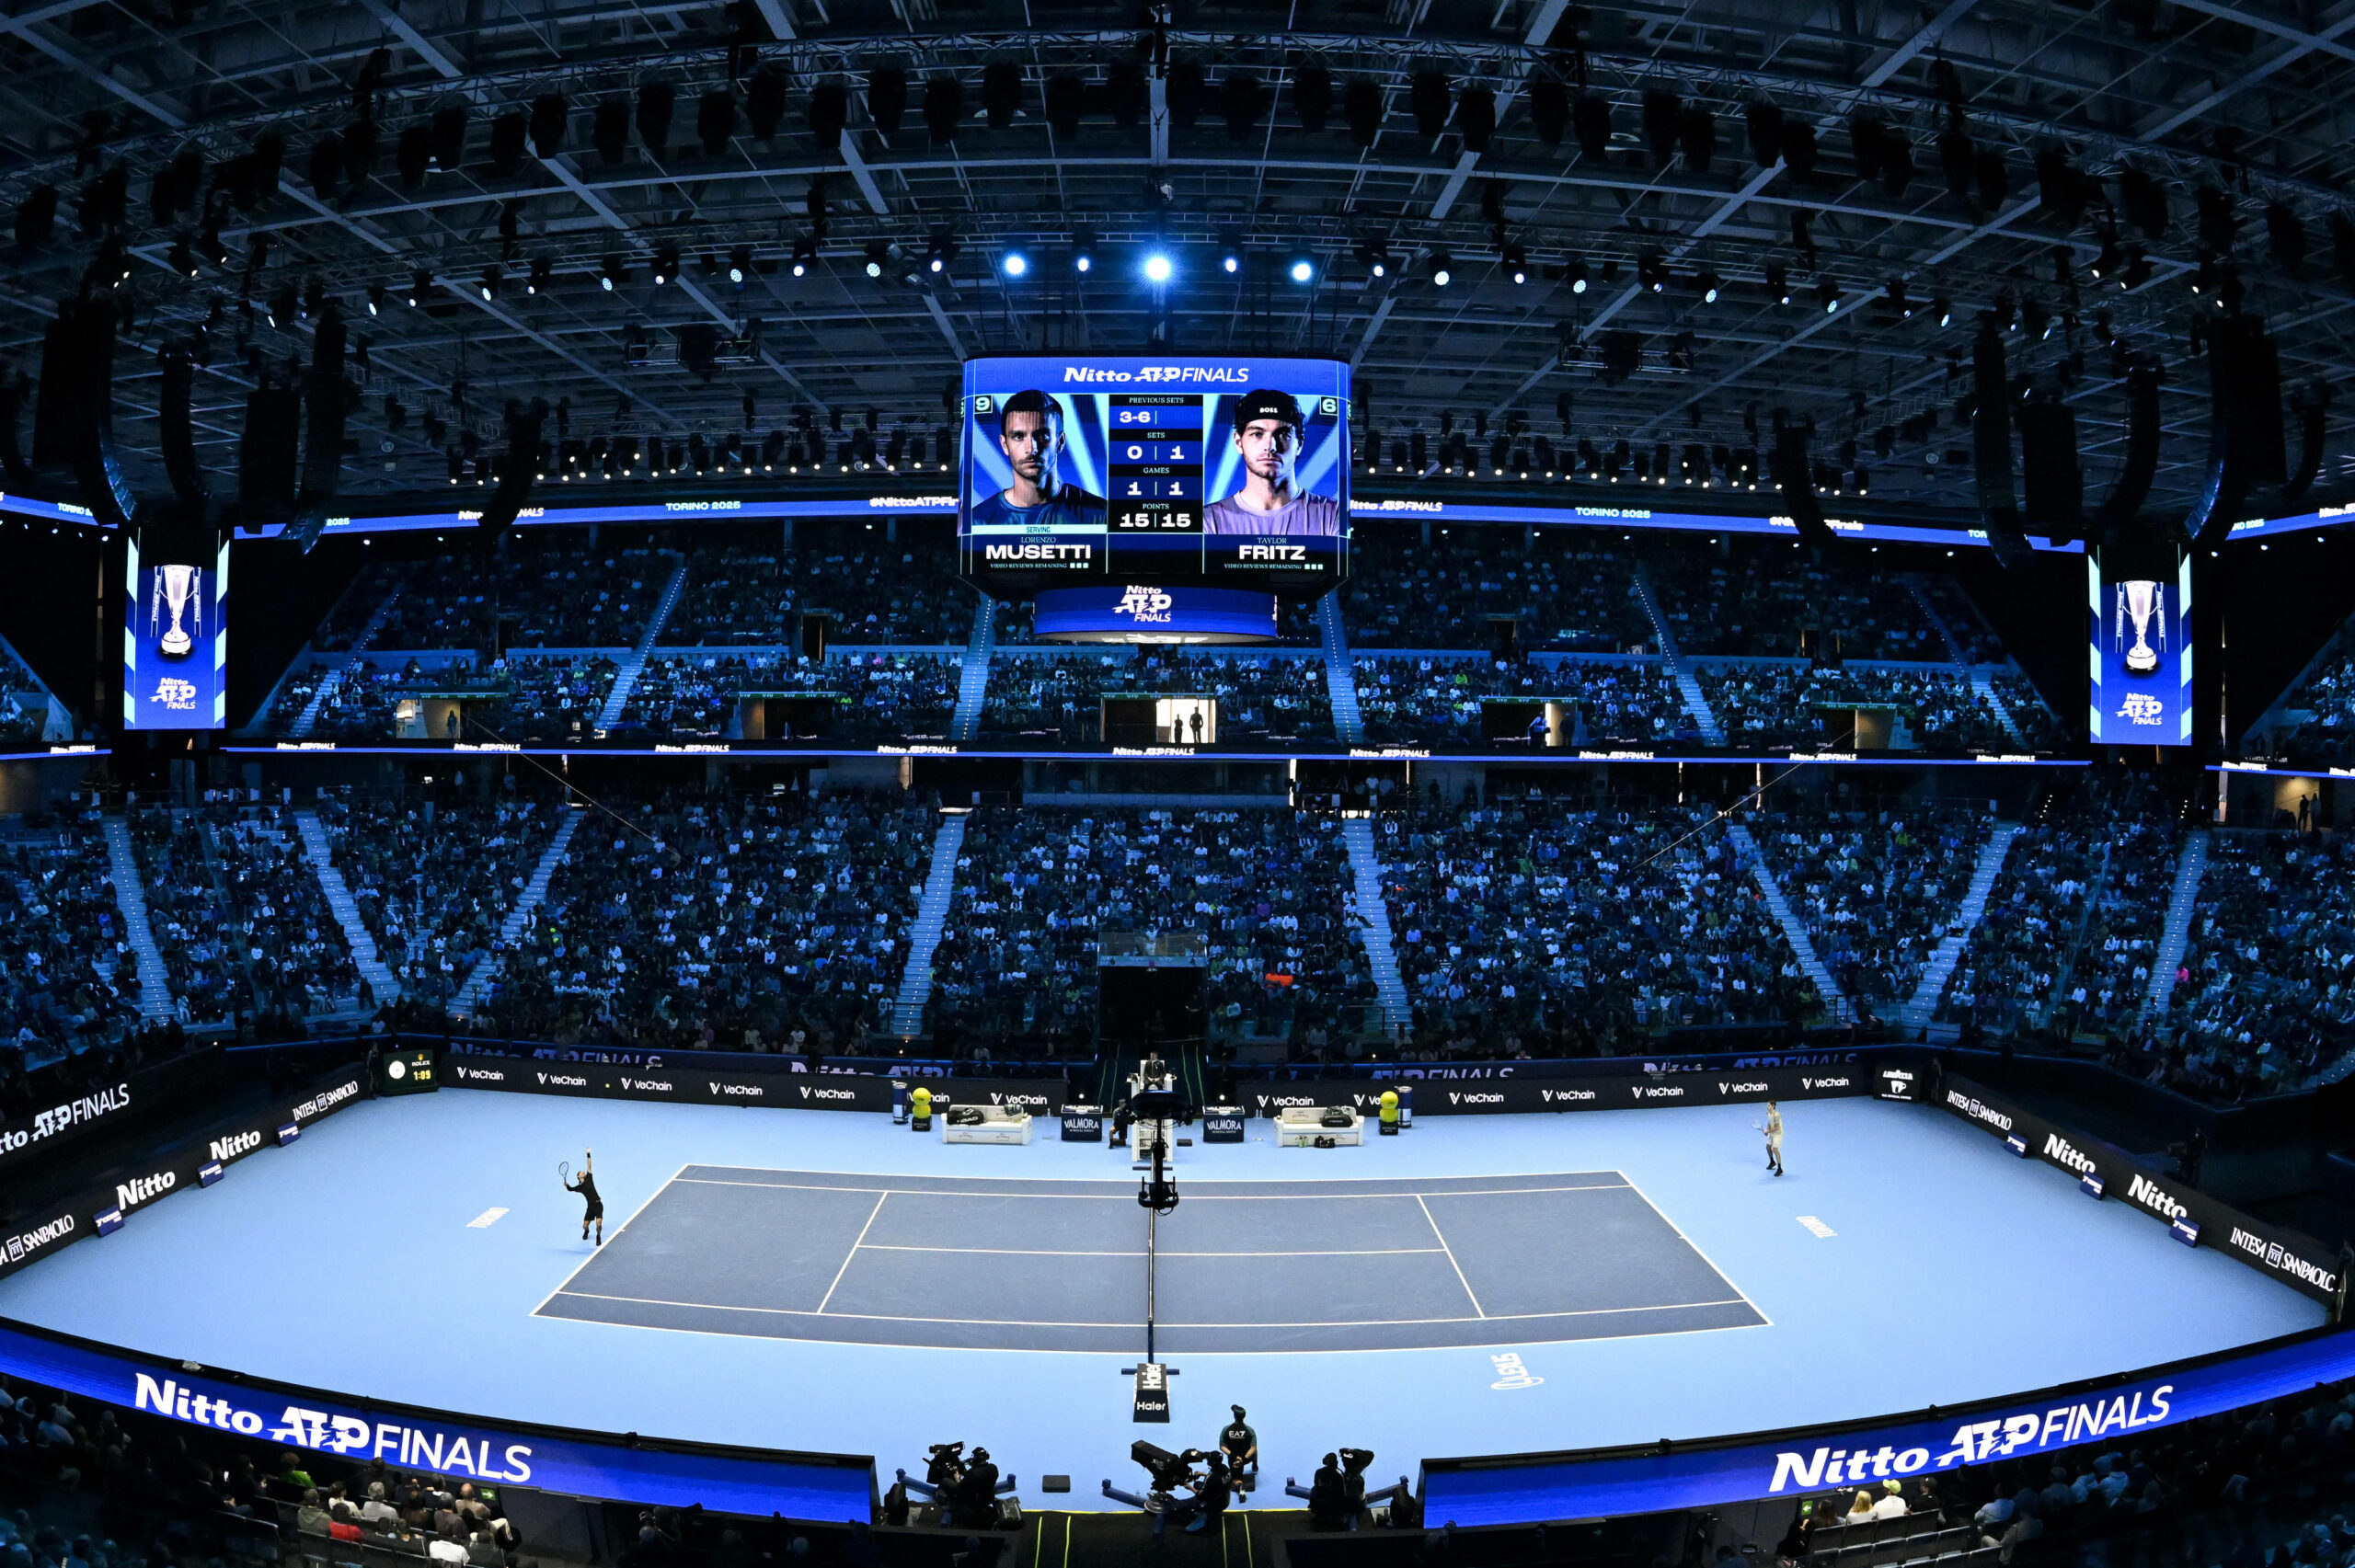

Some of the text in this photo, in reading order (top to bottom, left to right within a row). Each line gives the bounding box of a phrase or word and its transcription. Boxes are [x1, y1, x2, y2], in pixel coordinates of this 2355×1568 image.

[1063, 367, 1249, 383] Nitto ATP FINALS
[975, 396, 991, 411] 9
[1322, 398, 1337, 413] 6
[1119, 411, 1151, 424] 3-6
[1127, 445, 1143, 460] 0
[1170, 446, 1185, 460] 1
[1143, 466, 1170, 475] GAMES
[1127, 481, 1142, 497] 1
[1169, 481, 1184, 497] 1
[665, 500, 741, 512] TORINO 2025
[1142, 502, 1170, 510] POINTS
[1406, 501, 1442, 512] FINALS
[1575, 507, 1651, 520] TORINO 2025
[326, 518, 350, 526] 2025
[1120, 513, 1150, 529] 15
[1161, 513, 1191, 529] 15
[985, 544, 1091, 560] MUSETTI
[1238, 544, 1306, 561] FRITZ
[1125, 585, 1162, 595] Nitto
[1112, 594, 1172, 613] ATP
[1133, 612, 1172, 623] FINALS
[160, 678, 189, 686] Nitto
[149, 685, 197, 703] ATP
[2126, 692, 2155, 701] Nitto
[167, 701, 196, 710] FINALS
[2115, 700, 2163, 717] ATP
[2132, 716, 2162, 726] FINALS
[655, 743, 683, 753] Nitto
[702, 744, 729, 753] FINALS
[877, 744, 906, 755] Nitto
[927, 745, 957, 755] FINALS
[1112, 747, 1143, 756] Nitto
[1164, 748, 1194, 756] FINALS
[1350, 749, 1379, 759] Nitto
[1400, 750, 1430, 759] FINALS
[1626, 751, 1654, 760] FINALS
[413, 1070, 431, 1081] 1:09
[469, 1069, 504, 1081] VeChain
[550, 1074, 587, 1086] VeChain
[635, 1080, 672, 1092] VeChain
[1731, 1082, 1768, 1093] VeChain
[1815, 1077, 1849, 1088] VeChain
[723, 1084, 763, 1096] VeChain
[814, 1088, 856, 1100] VeChain
[1556, 1090, 1595, 1101] VeChain
[1646, 1086, 1683, 1097] VeChain
[293, 1081, 359, 1121] INTESA SANPAOLO
[1005, 1093, 1048, 1105] VeChain
[1272, 1095, 1315, 1106] VeChain
[1464, 1093, 1504, 1104] VeChain
[30, 1104, 71, 1141] ATP
[72, 1083, 130, 1125] FINALS
[1947, 1090, 2013, 1131] INTESA SANPAOLO
[1063, 1118, 1099, 1129] VALMORA
[1206, 1119, 1242, 1131] VALMORA
[210, 1131, 261, 1161] Nitto
[2043, 1133, 2096, 1173] Nitto
[116, 1171, 176, 1210] Nitto
[2127, 1173, 2188, 1219] Nitto
[23, 1214, 75, 1252] SANPAOLO
[2230, 1227, 2267, 1259] INTESA
[1136, 1401, 1166, 1411] Haier
[134, 1372, 533, 1482] Nitto ATP FINALS
[1768, 1385, 2174, 1493] Nitto ATP FINALS
